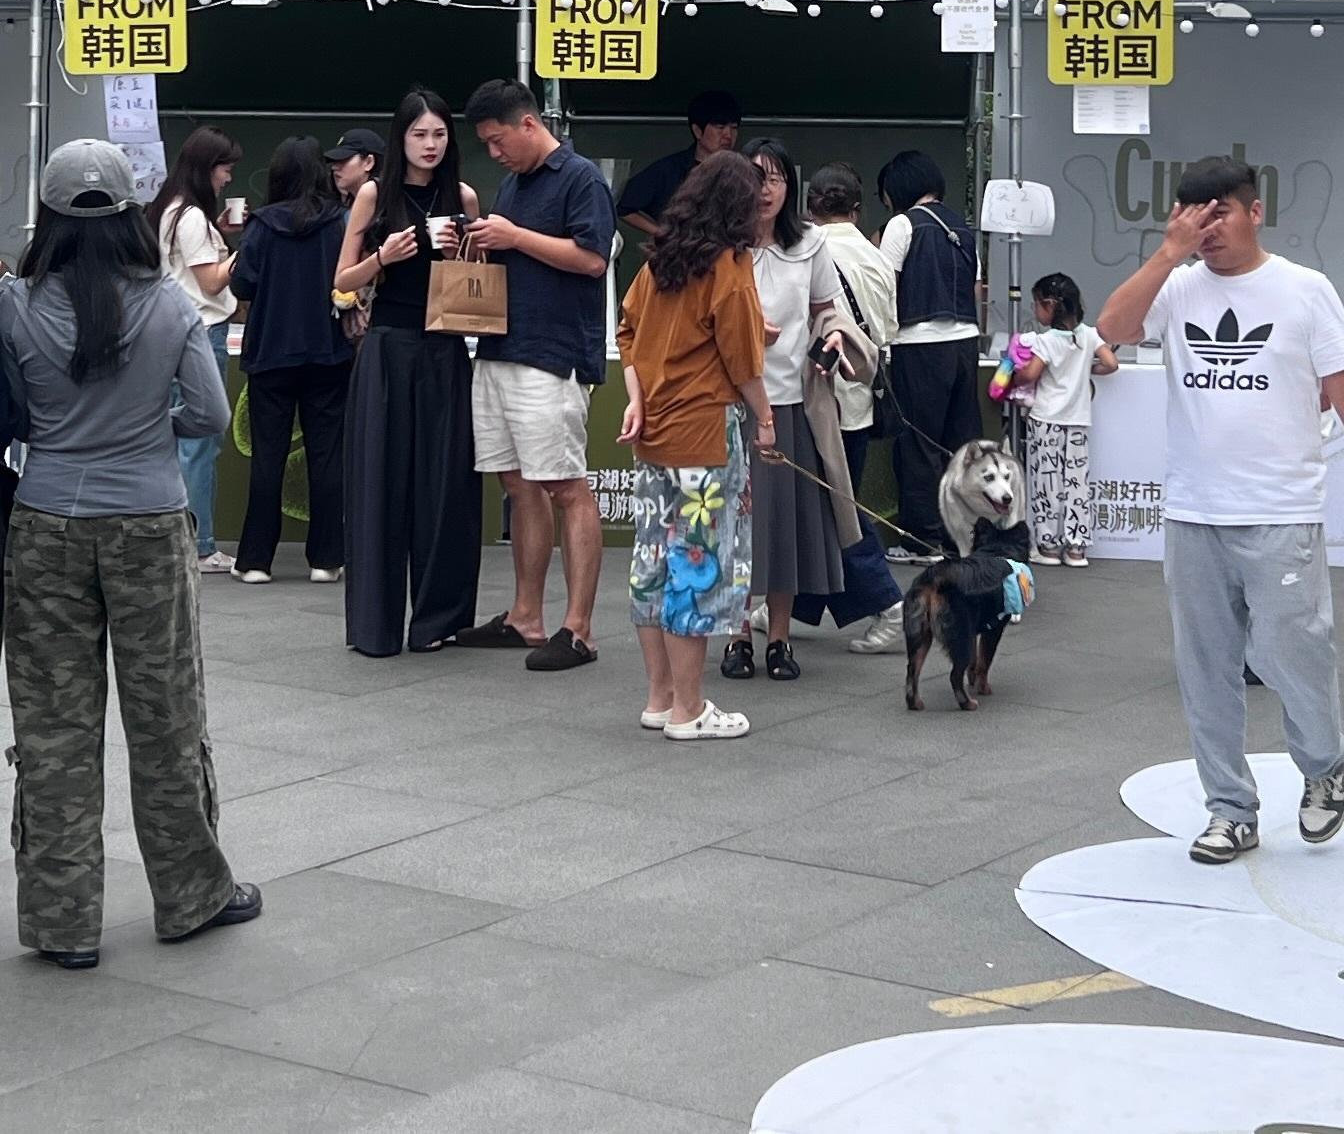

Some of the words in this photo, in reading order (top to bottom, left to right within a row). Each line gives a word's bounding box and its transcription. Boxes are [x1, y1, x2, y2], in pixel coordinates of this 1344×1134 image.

[1061, 0, 1162, 30] FROM
[81, 24, 172, 68] 韩国
[552, 30, 642, 74] 韩国
[1065, 34, 1157, 79] 韩国
[1183, 368, 1270, 392] adidas
